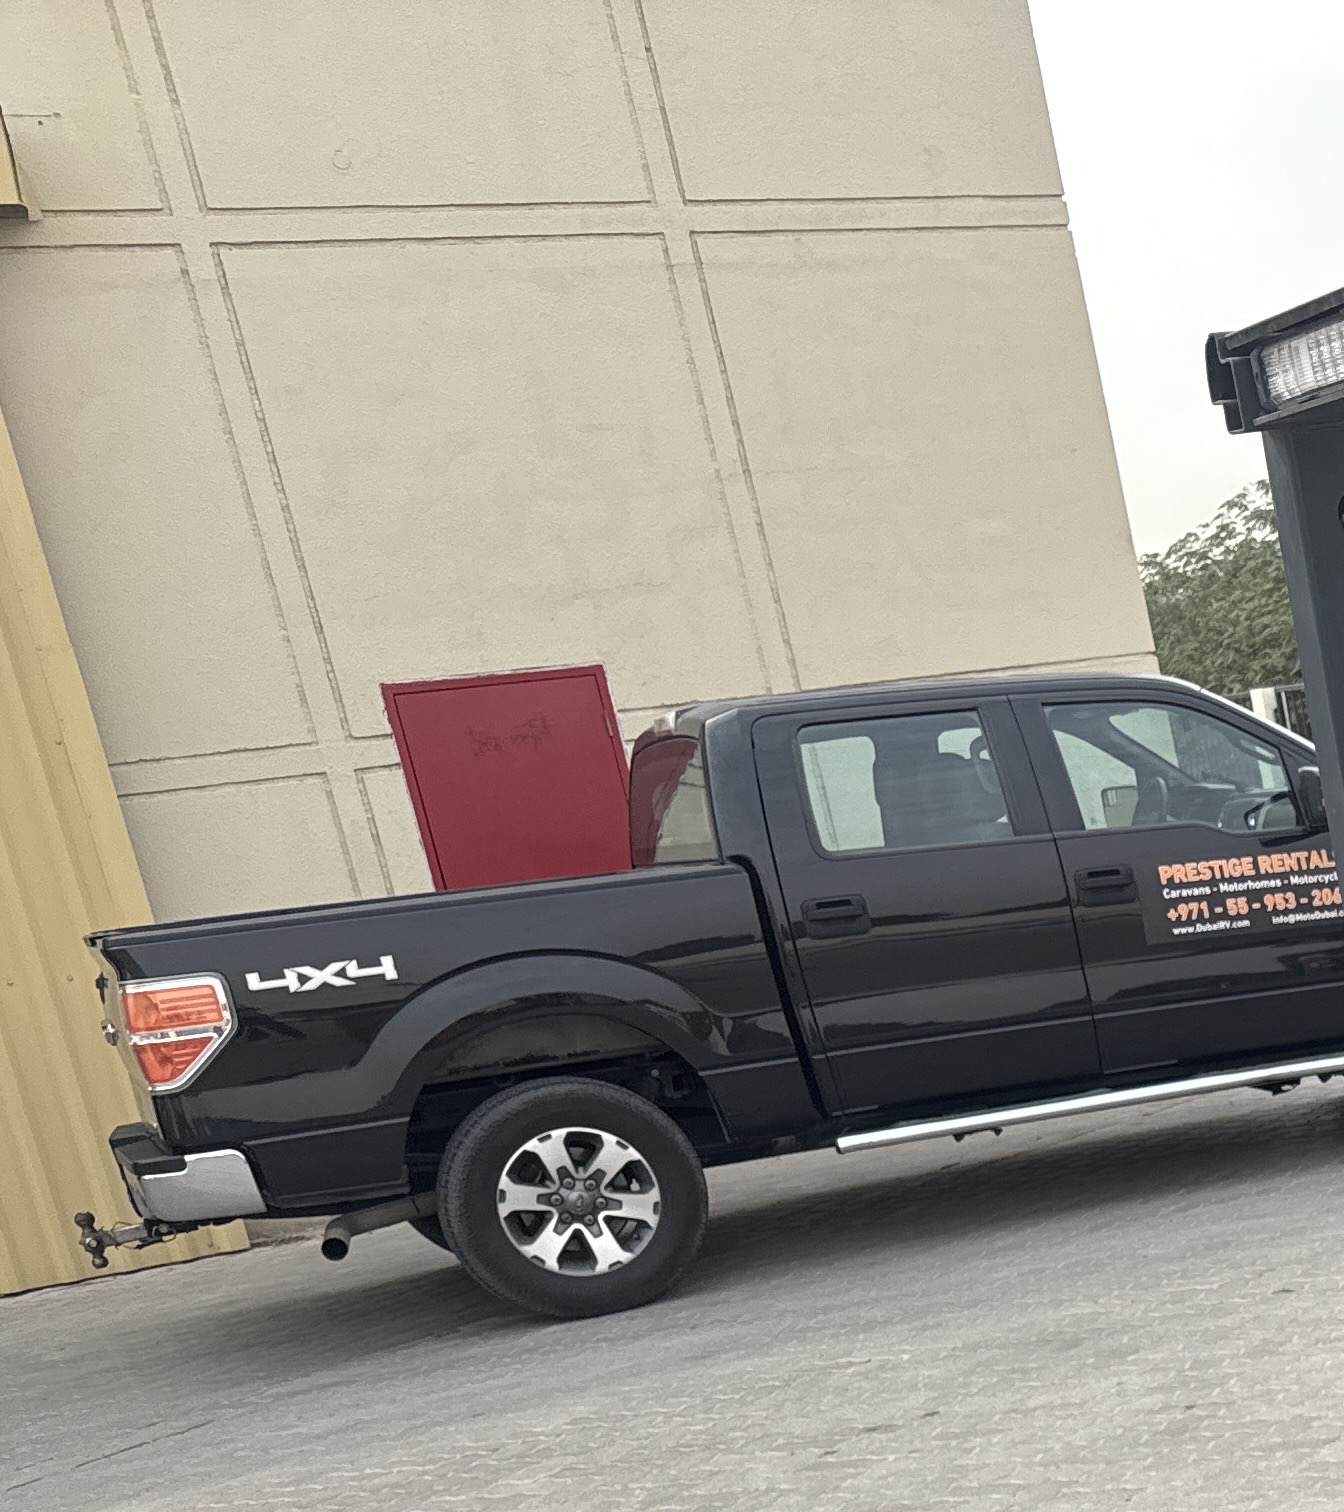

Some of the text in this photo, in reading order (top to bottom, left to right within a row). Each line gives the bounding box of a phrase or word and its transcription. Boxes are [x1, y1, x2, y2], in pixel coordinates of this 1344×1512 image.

[1158, 849, 1336, 886] PRESTIGE RENTAL
[1162, 885, 1212, 900] Caravans
[1218, 877, 1283, 894] Motorhomes
[1166, 900, 1211, 922] +971
[1225, 896, 1250, 917] 55
[1263, 891, 1298, 913] 953
